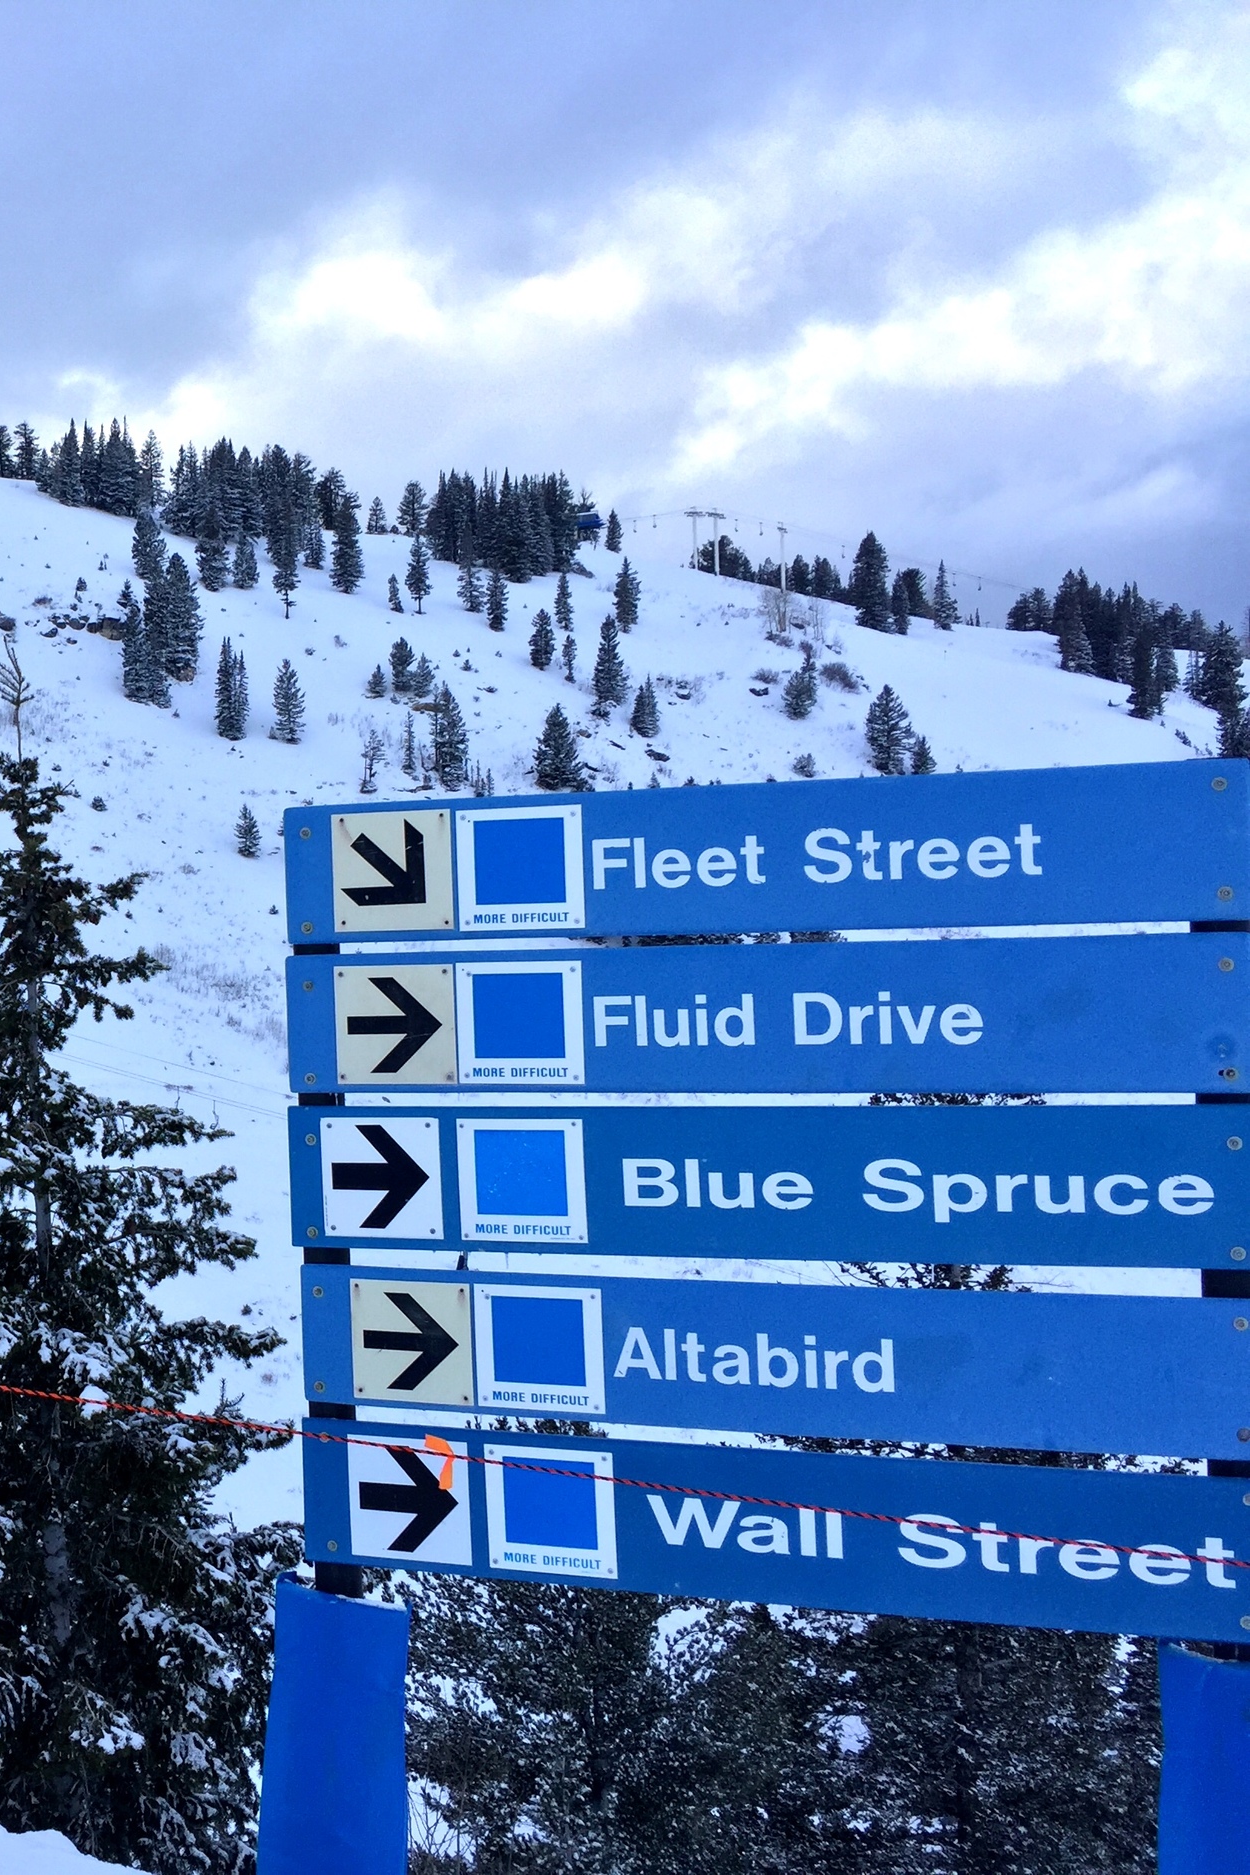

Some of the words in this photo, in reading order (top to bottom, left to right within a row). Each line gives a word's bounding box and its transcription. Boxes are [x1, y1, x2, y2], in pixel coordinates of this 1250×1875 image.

[592, 835, 766, 890] Fleet
[803, 823, 1043, 884] Street
[473, 913, 507, 925] MORE
[511, 911, 570, 924] DIFFICULT
[593, 993, 756, 1047] Fluid
[793, 991, 984, 1045] Drive
[472, 1067, 506, 1079] MORE
[510, 1066, 569, 1078] DIFFICULT
[622, 1158, 814, 1210] Blue
[862, 1158, 1215, 1223] Spruce
[475, 1223, 509, 1235] MORE
[513, 1224, 572, 1236] DIFFICULT
[613, 1326, 895, 1393] Altabird
[492, 1390, 526, 1403] MORE
[530, 1392, 590, 1407] DIFFICULT
[646, 1494, 844, 1559] Wall
[898, 1514, 1236, 1589] Street
[503, 1551, 537, 1565] MORE
[542, 1555, 602, 1570] DIFFICULT
